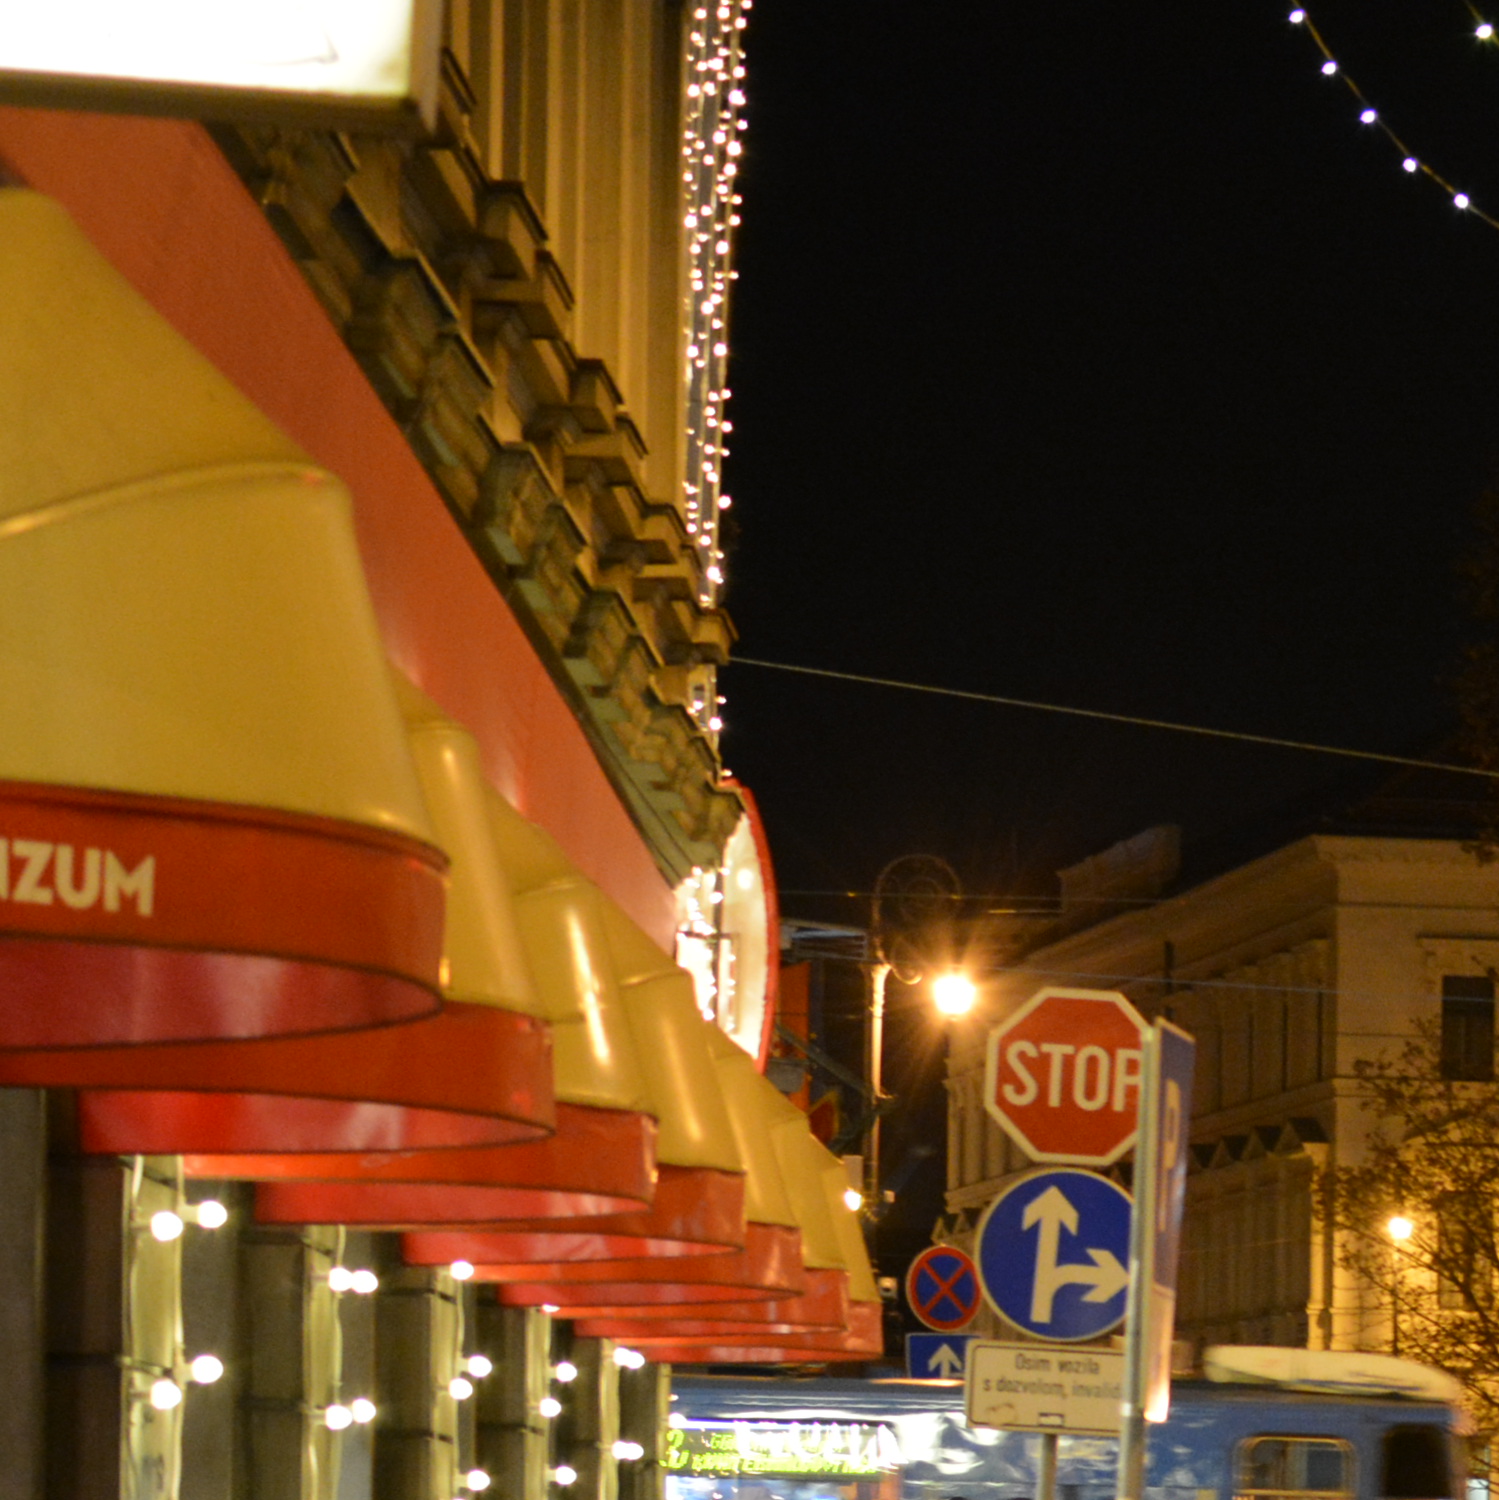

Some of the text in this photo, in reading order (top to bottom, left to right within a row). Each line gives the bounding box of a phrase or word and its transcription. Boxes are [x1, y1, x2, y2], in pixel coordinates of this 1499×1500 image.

[0, 837, 155, 917] ZUM
[1003, 1040, 1142, 1111] STOP
[1058, 1357, 1099, 1375] vozila
